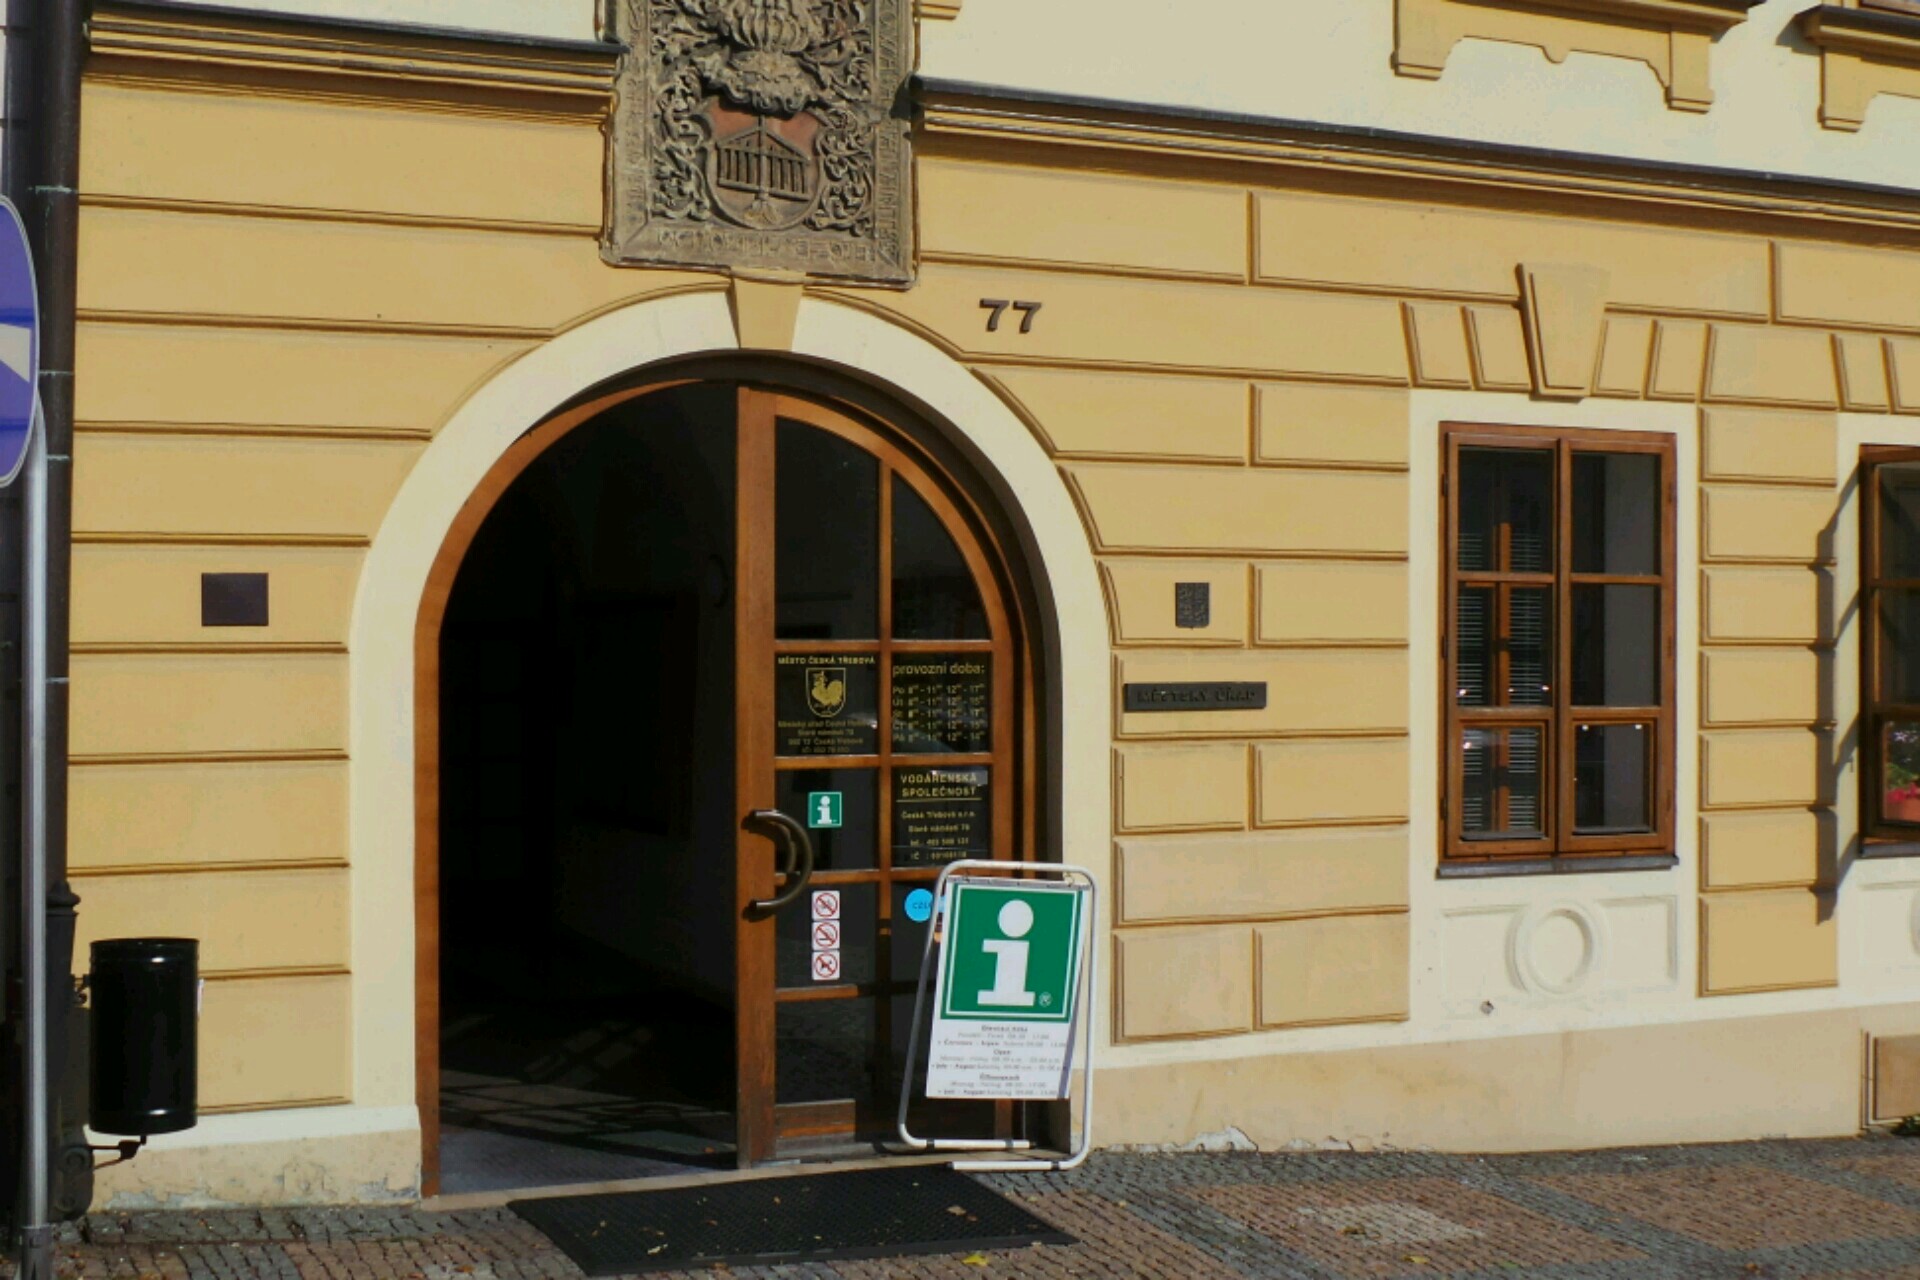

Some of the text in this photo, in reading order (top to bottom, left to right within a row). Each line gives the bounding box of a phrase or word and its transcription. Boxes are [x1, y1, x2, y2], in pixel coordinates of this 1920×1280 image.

[979, 298, 1042, 334] 77
[893, 661, 985, 678] provozní doba:
[900, 771, 977, 784] VODÁRENSKÁ
[901, 785, 977, 797] SPOLEČNOST
